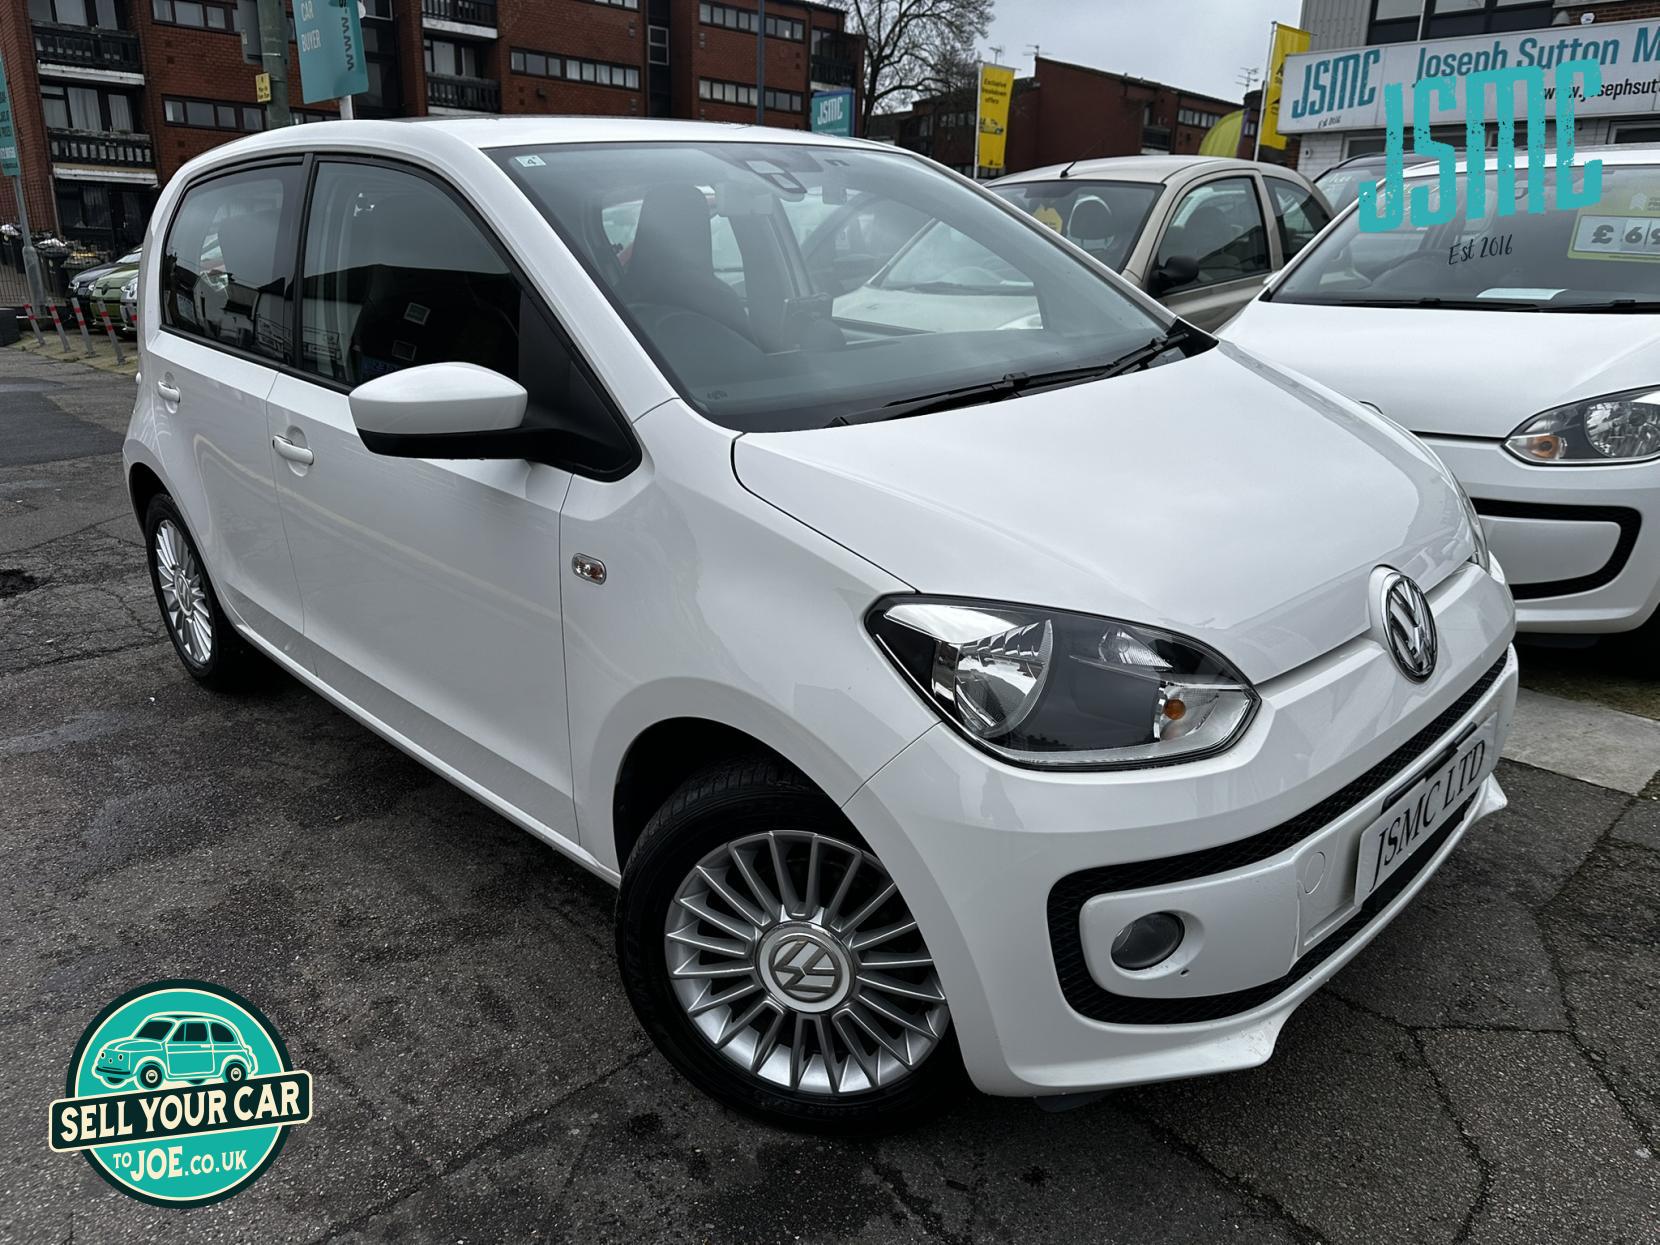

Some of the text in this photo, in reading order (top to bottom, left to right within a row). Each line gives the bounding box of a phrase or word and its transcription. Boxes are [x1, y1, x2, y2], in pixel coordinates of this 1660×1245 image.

[301, 29, 321, 52] BUYER
[1412, 41, 1508, 88] Joseph
[1516, 38, 1620, 70] Sutton
[1291, 49, 1380, 119] JSMC
[817, 96, 843, 125] JSMC
[1369, 739, 1485, 892] JSMC LTD
